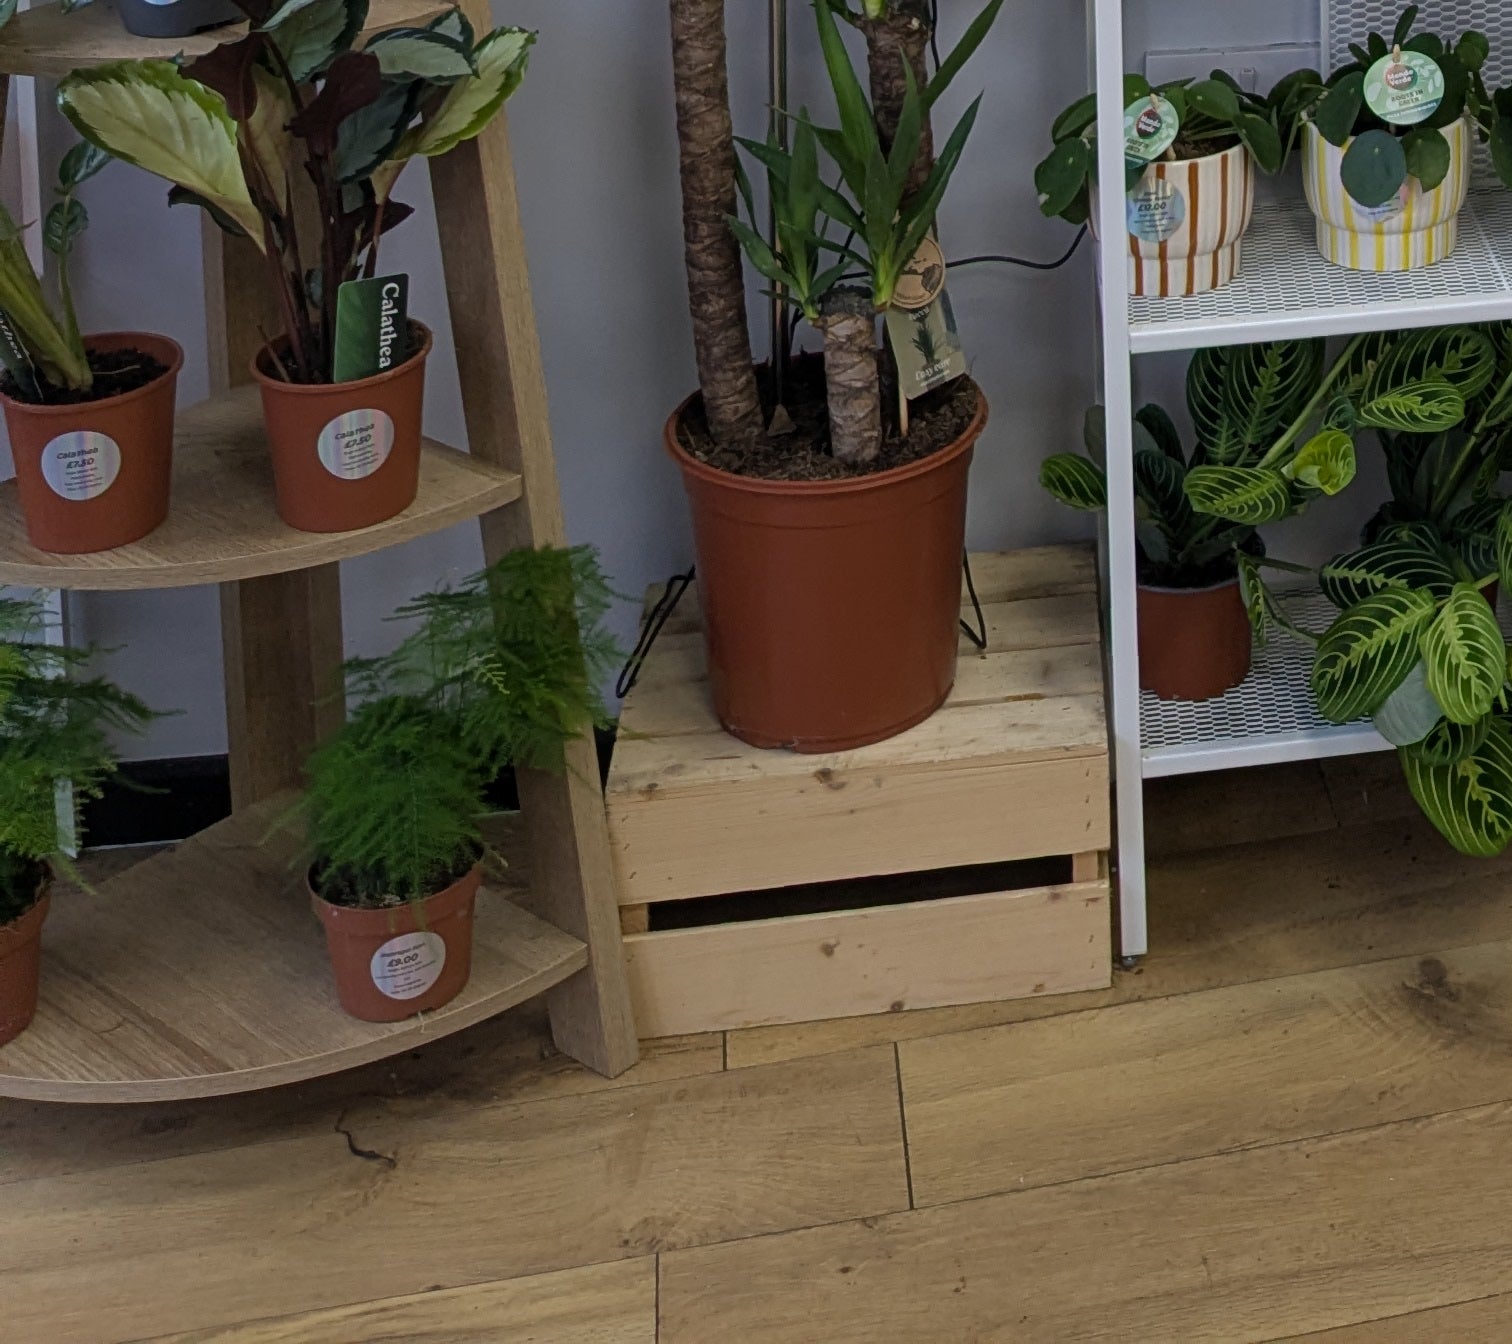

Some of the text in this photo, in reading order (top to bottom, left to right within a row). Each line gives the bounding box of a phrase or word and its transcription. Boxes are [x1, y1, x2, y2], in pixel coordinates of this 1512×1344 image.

[1387, 70, 1414, 80] Mondo
[1391, 76, 1411, 86] Verde
[379, 282, 400, 368] Calathea
[56, 447, 98, 459] Calathea
[66, 457, 95, 469] £7.50
